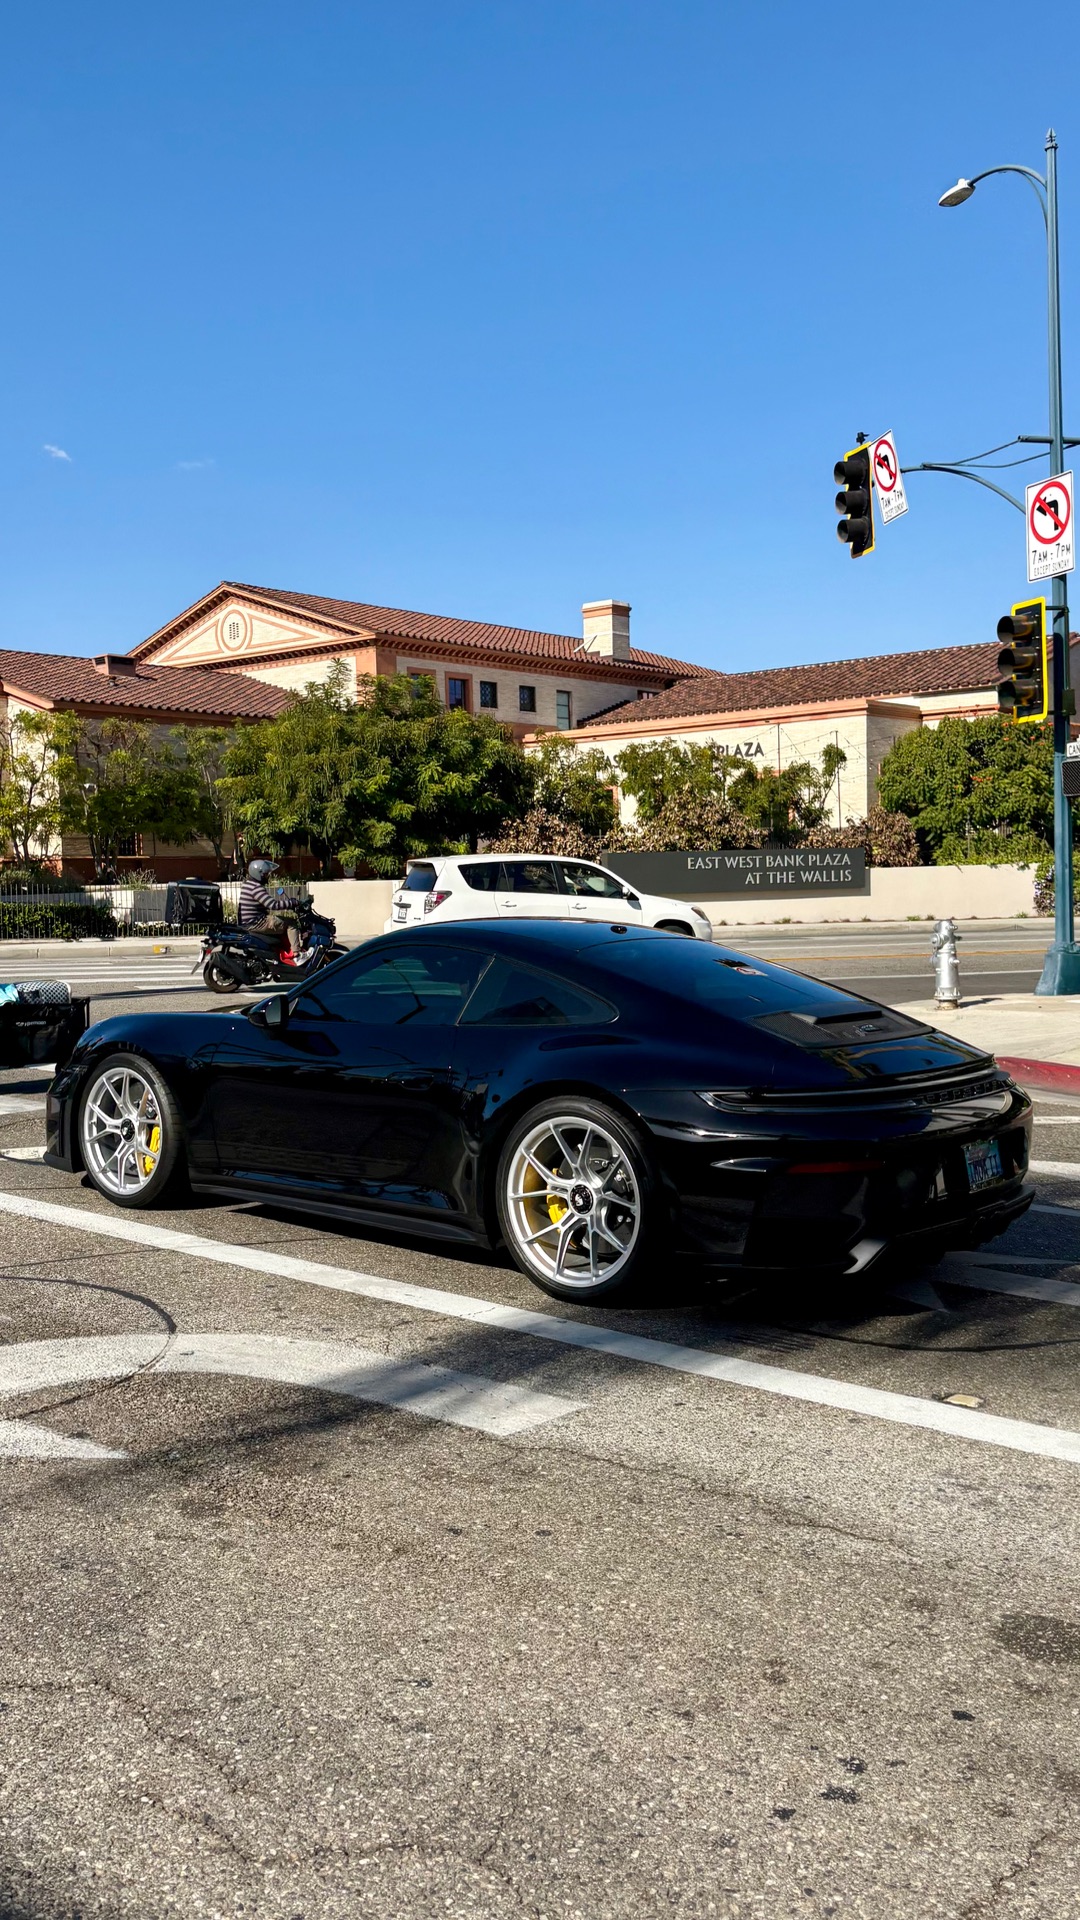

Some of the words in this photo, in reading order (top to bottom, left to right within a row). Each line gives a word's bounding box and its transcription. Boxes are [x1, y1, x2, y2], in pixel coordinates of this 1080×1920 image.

[716, 741, 765, 758] PLAZA
[687, 857, 722, 870] EAST
[724, 855, 763, 869] WEST
[765, 854, 805, 868] BANK
[808, 853, 852, 866] PLAZA
[745, 872, 763, 885] AT
[766, 871, 796, 884] THE
[800, 869, 852, 883] WALLIS
